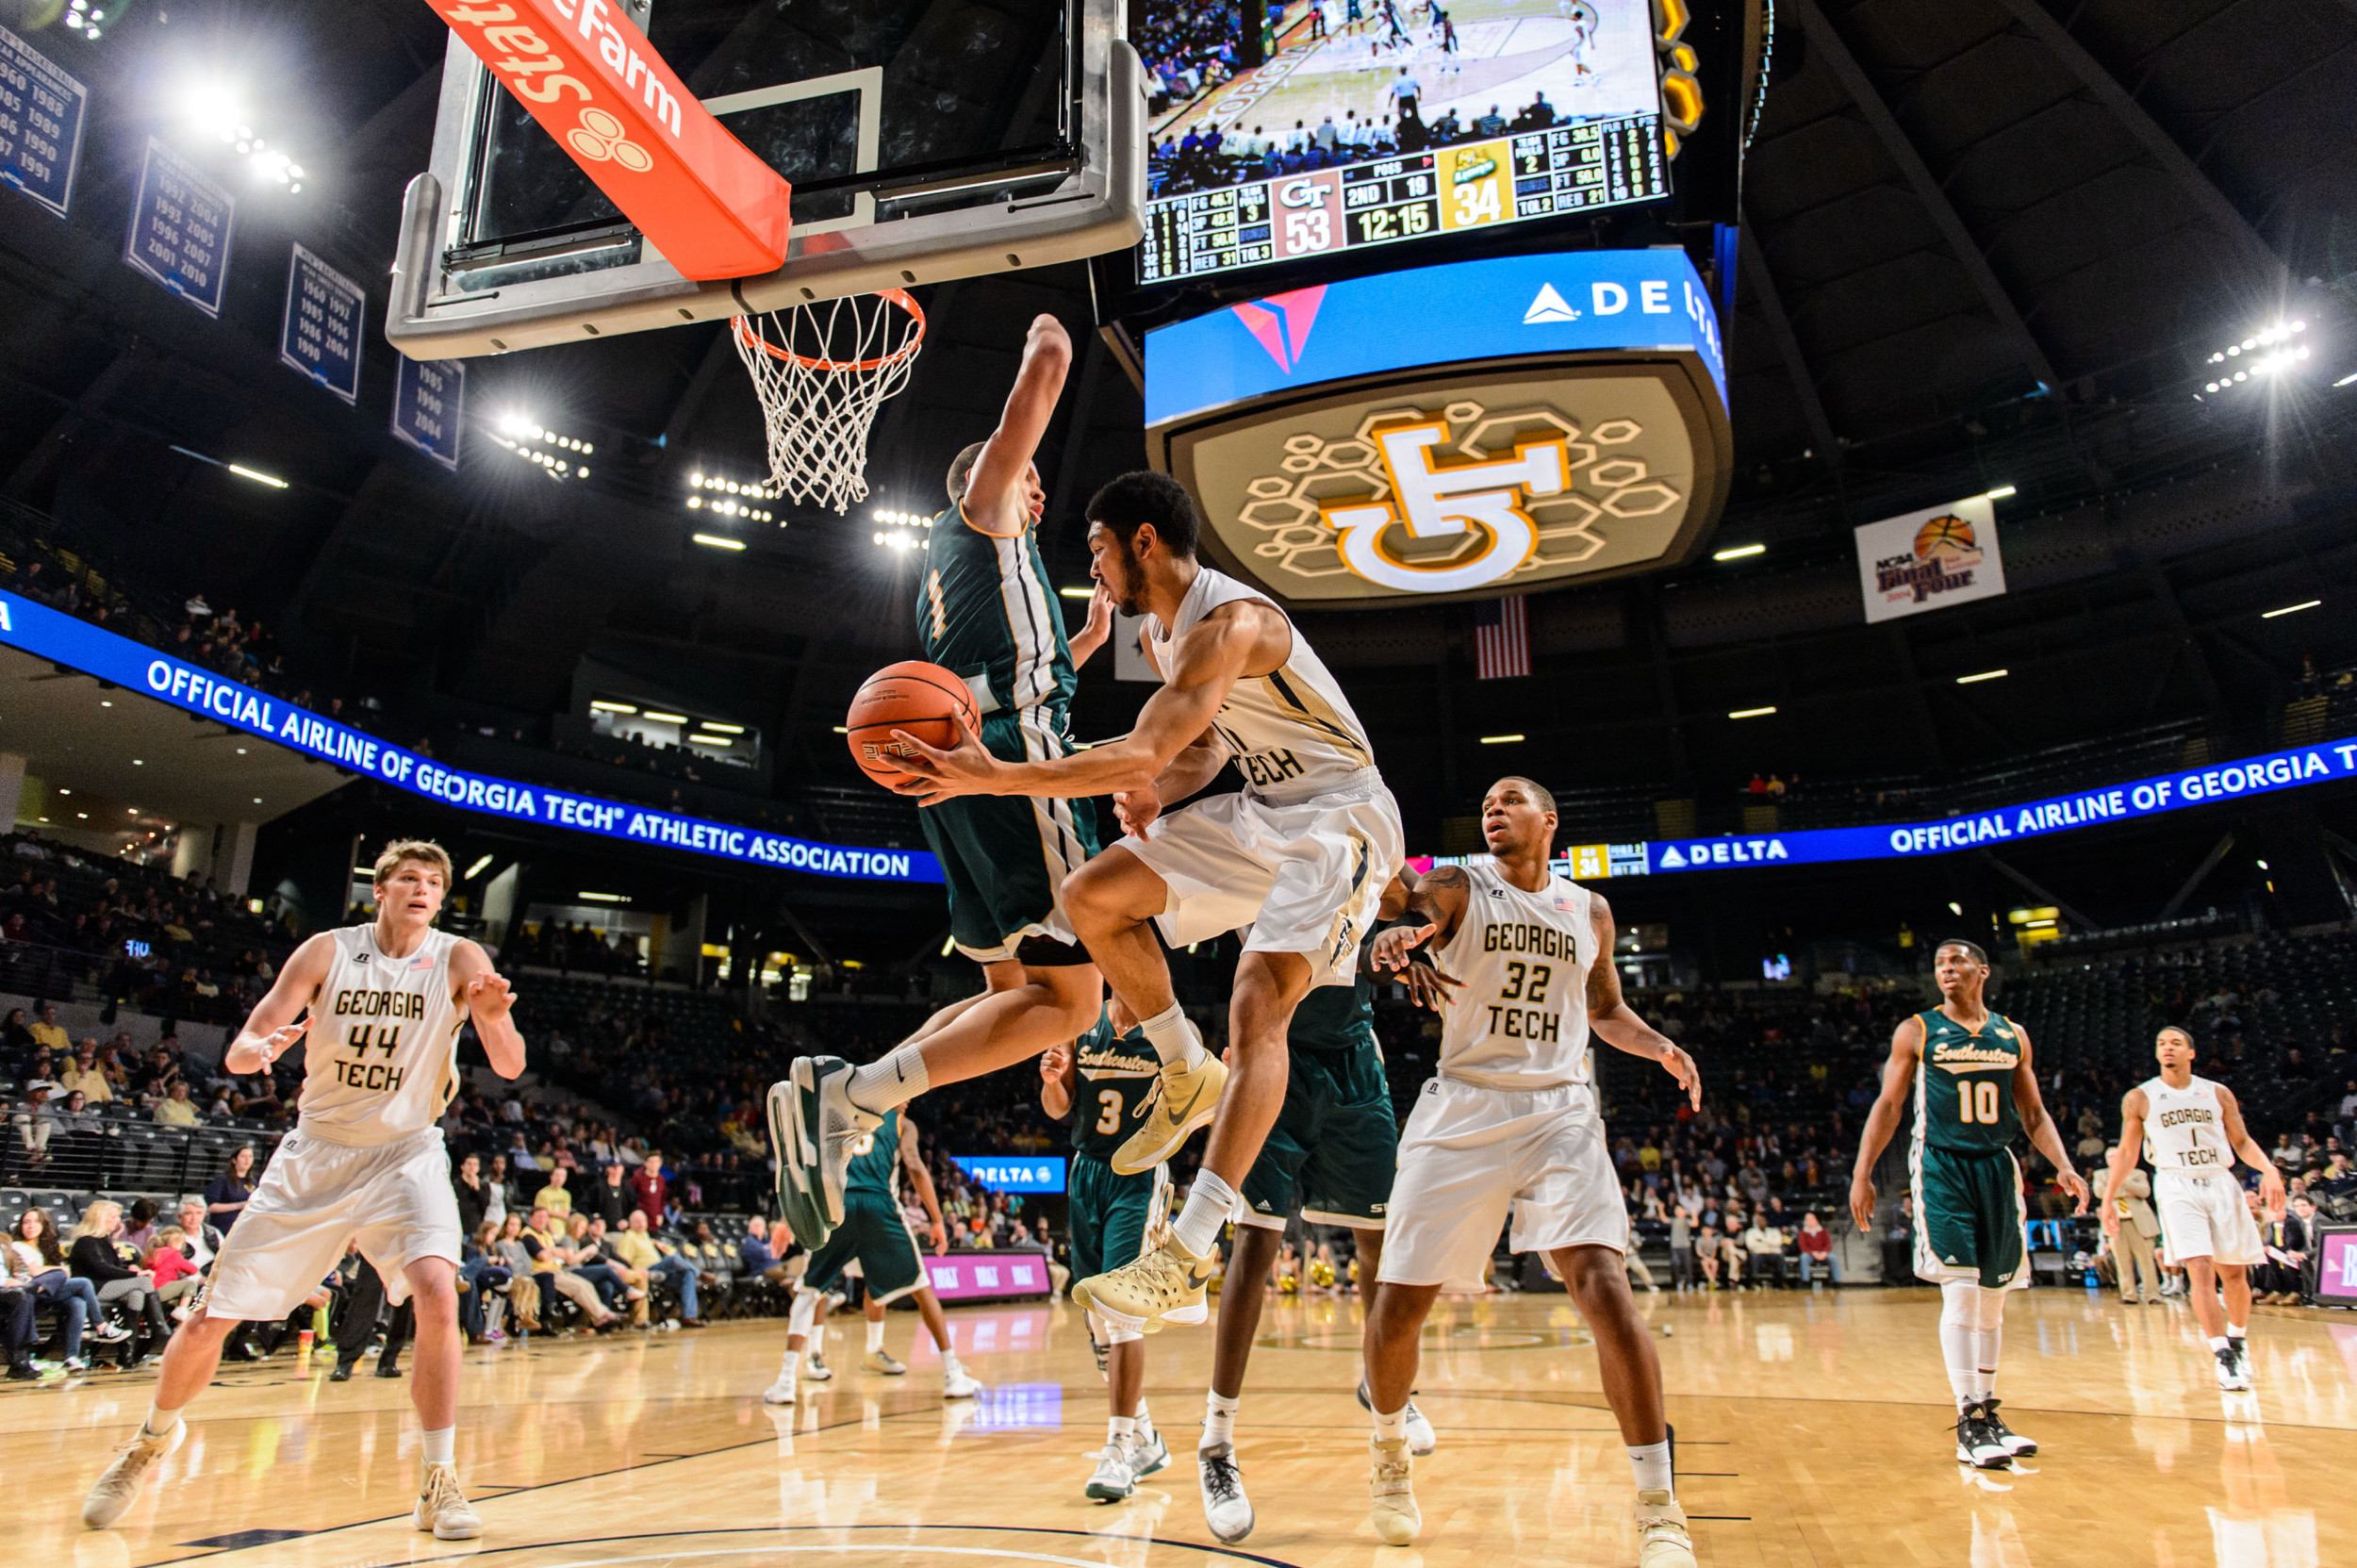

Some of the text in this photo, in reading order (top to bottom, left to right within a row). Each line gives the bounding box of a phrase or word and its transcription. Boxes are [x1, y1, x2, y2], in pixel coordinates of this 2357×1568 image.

[0, 61, 26, 91] 960
[0, 85, 60, 140] 85 1989
[0, 112, 58, 162] 86 1990
[21, 152, 51, 183] 1991
[1525, 157, 1539, 173] 2
[1347, 175, 1427, 207] 2ND 19
[1453, 179, 1501, 225] 34
[1246, 205, 1259, 222] 3
[1359, 203, 1429, 241] 12:15
[1286, 209, 1330, 255] 53
[147, 660, 274, 734] OFFICIAL
[280, 712, 379, 771] AIRLINE
[381, 750, 412, 783] OF
[416, 763, 536, 817] GEORGIA
[627, 813, 745, 857] ATHLETIC
[749, 839, 910, 877] ASSOCIATION
[1890, 815, 2012, 852] OFFICIAL
[2017, 791, 2126, 834] AIRLINE
[2132, 782, 2172, 810] OF
[2180, 751, 2330, 801] GEORGIA
[1579, 857, 1601, 877] 34
[1690, 839, 1788, 866] DELTA
[1485, 923, 1576, 964] GEORGIA
[1501, 961, 1551, 1003] 32
[335, 990, 424, 1020] GEORGIA
[1488, 1005, 1559, 1043] TECH
[349, 1024, 402, 1060] 44
[1077, 1044, 1160, 1073] Southeastern
[335, 1060, 404, 1091] TECH
[1096, 1089, 1123, 1135] 3
[1957, 1081, 1999, 1124] 10
[2160, 1108, 2214, 1129] GEORGIA
[2191, 1129, 2198, 1147] 1
[2178, 1148, 2217, 1166] TECH
[972, 1166, 1034, 1183] DELTA
